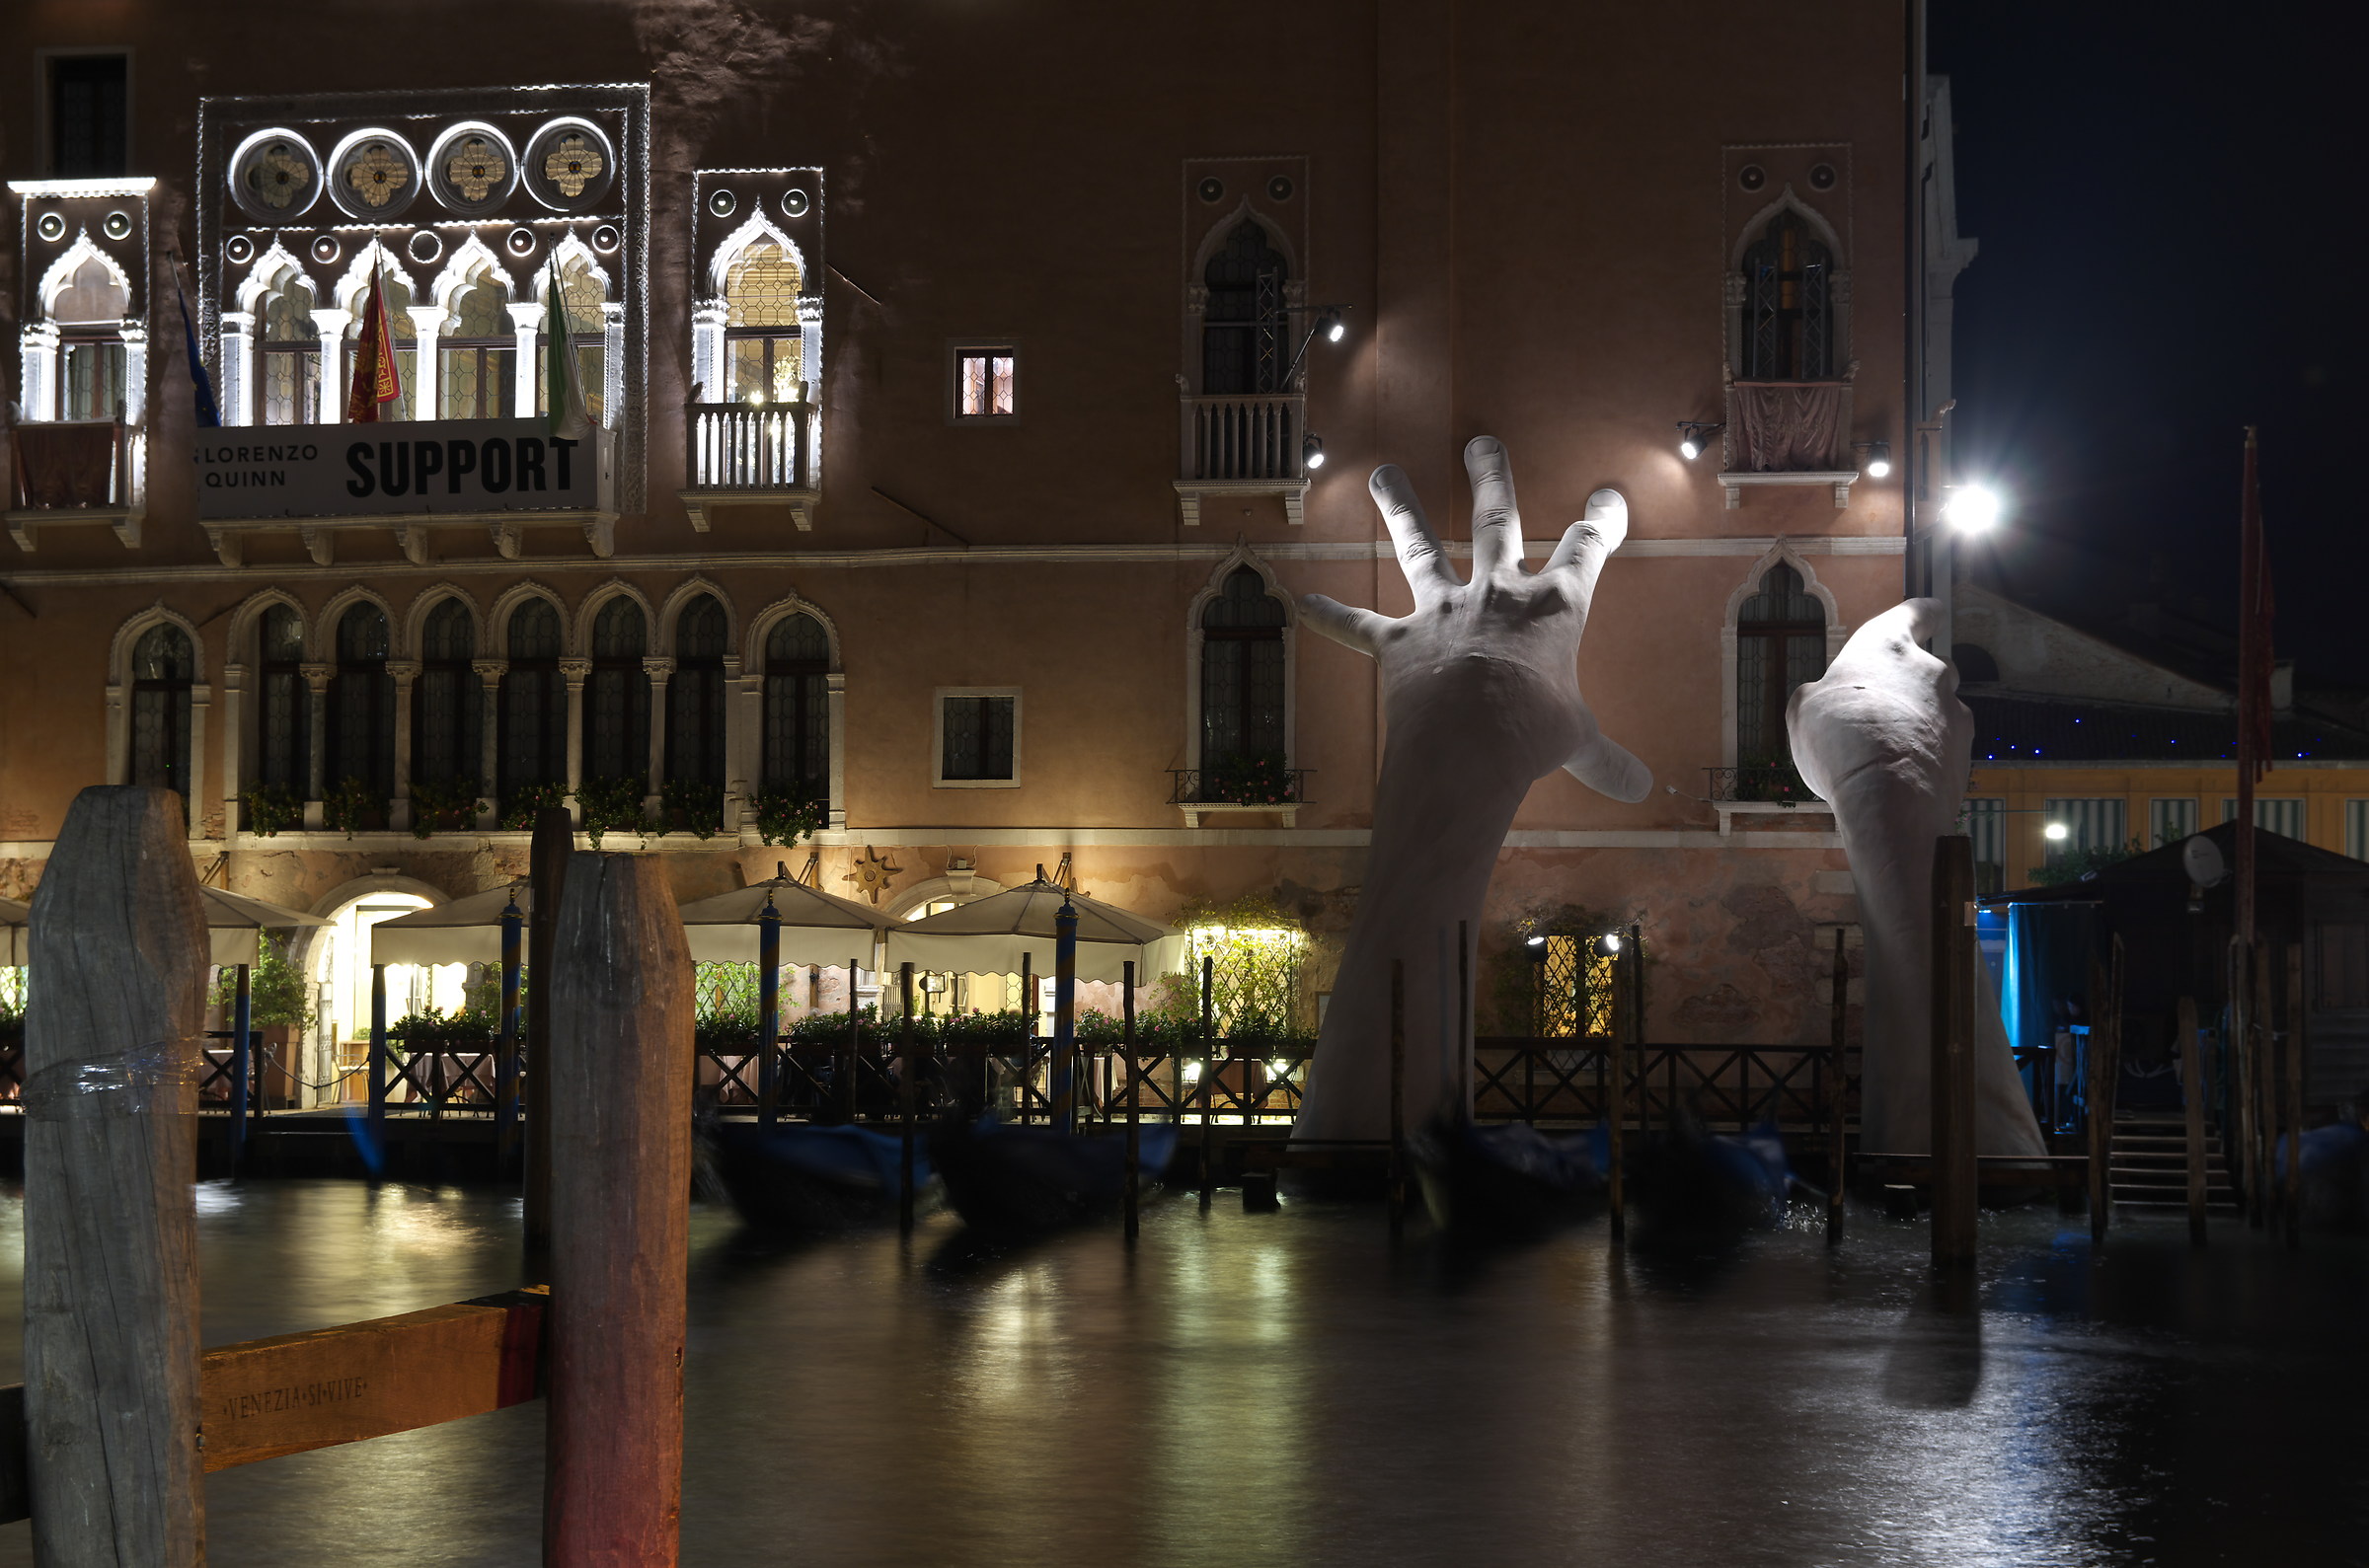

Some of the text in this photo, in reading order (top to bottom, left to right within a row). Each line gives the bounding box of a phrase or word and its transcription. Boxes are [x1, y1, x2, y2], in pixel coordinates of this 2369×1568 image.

[205, 444, 318, 463] LORENZO
[346, 437, 578, 498] SUPPORT
[205, 470, 285, 487] QUINN
